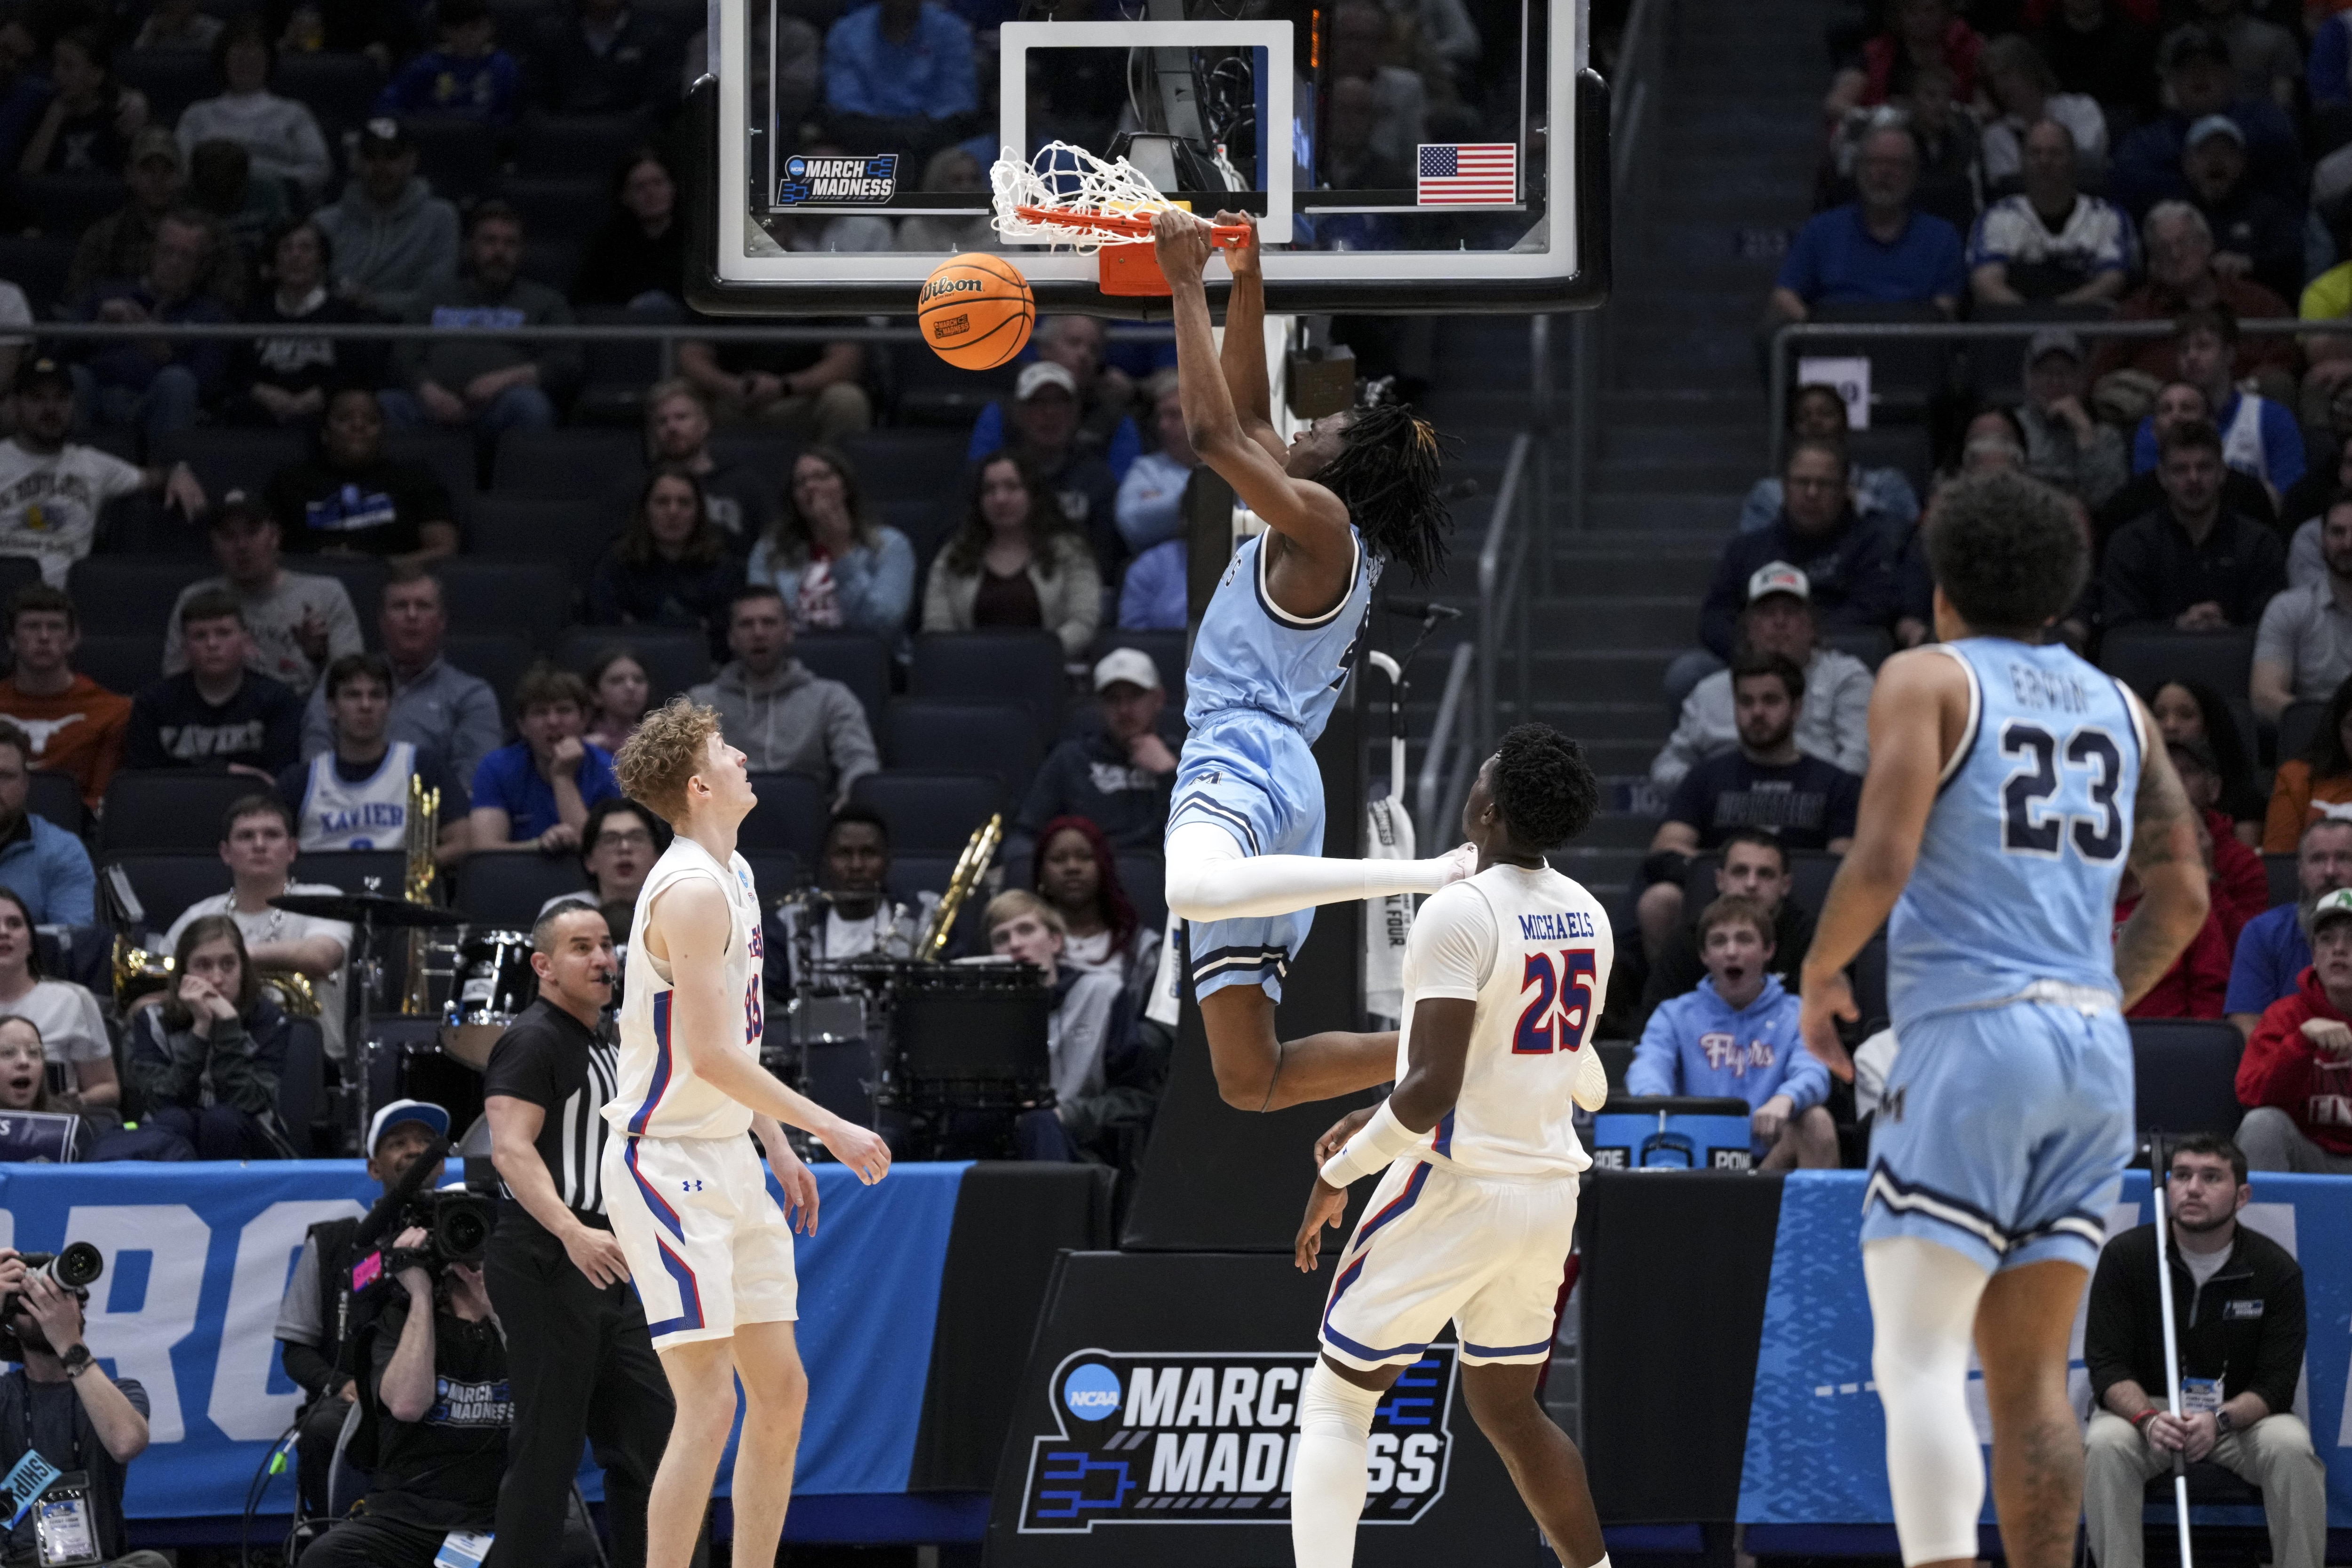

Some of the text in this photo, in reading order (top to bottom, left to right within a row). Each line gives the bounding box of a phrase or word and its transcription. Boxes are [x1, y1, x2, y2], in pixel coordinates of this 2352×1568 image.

[805, 161, 865, 178] MARCH
[812, 179, 892, 196] MADNESS
[921, 276, 983, 305] Wilson
[938, 318, 957, 328] MARCH
[942, 323, 969, 335] MADNESS
[1999, 717, 2123, 866] 23
[320, 803, 403, 833] XAVIER
[1386, 910, 1405, 949] FOUR
[1518, 912, 1594, 940] MICHAELS
[1511, 949, 1596, 1054] 25
[1070, 1391, 1119, 1406] NCAA
[1148, 1433, 1438, 1494] MADSS
